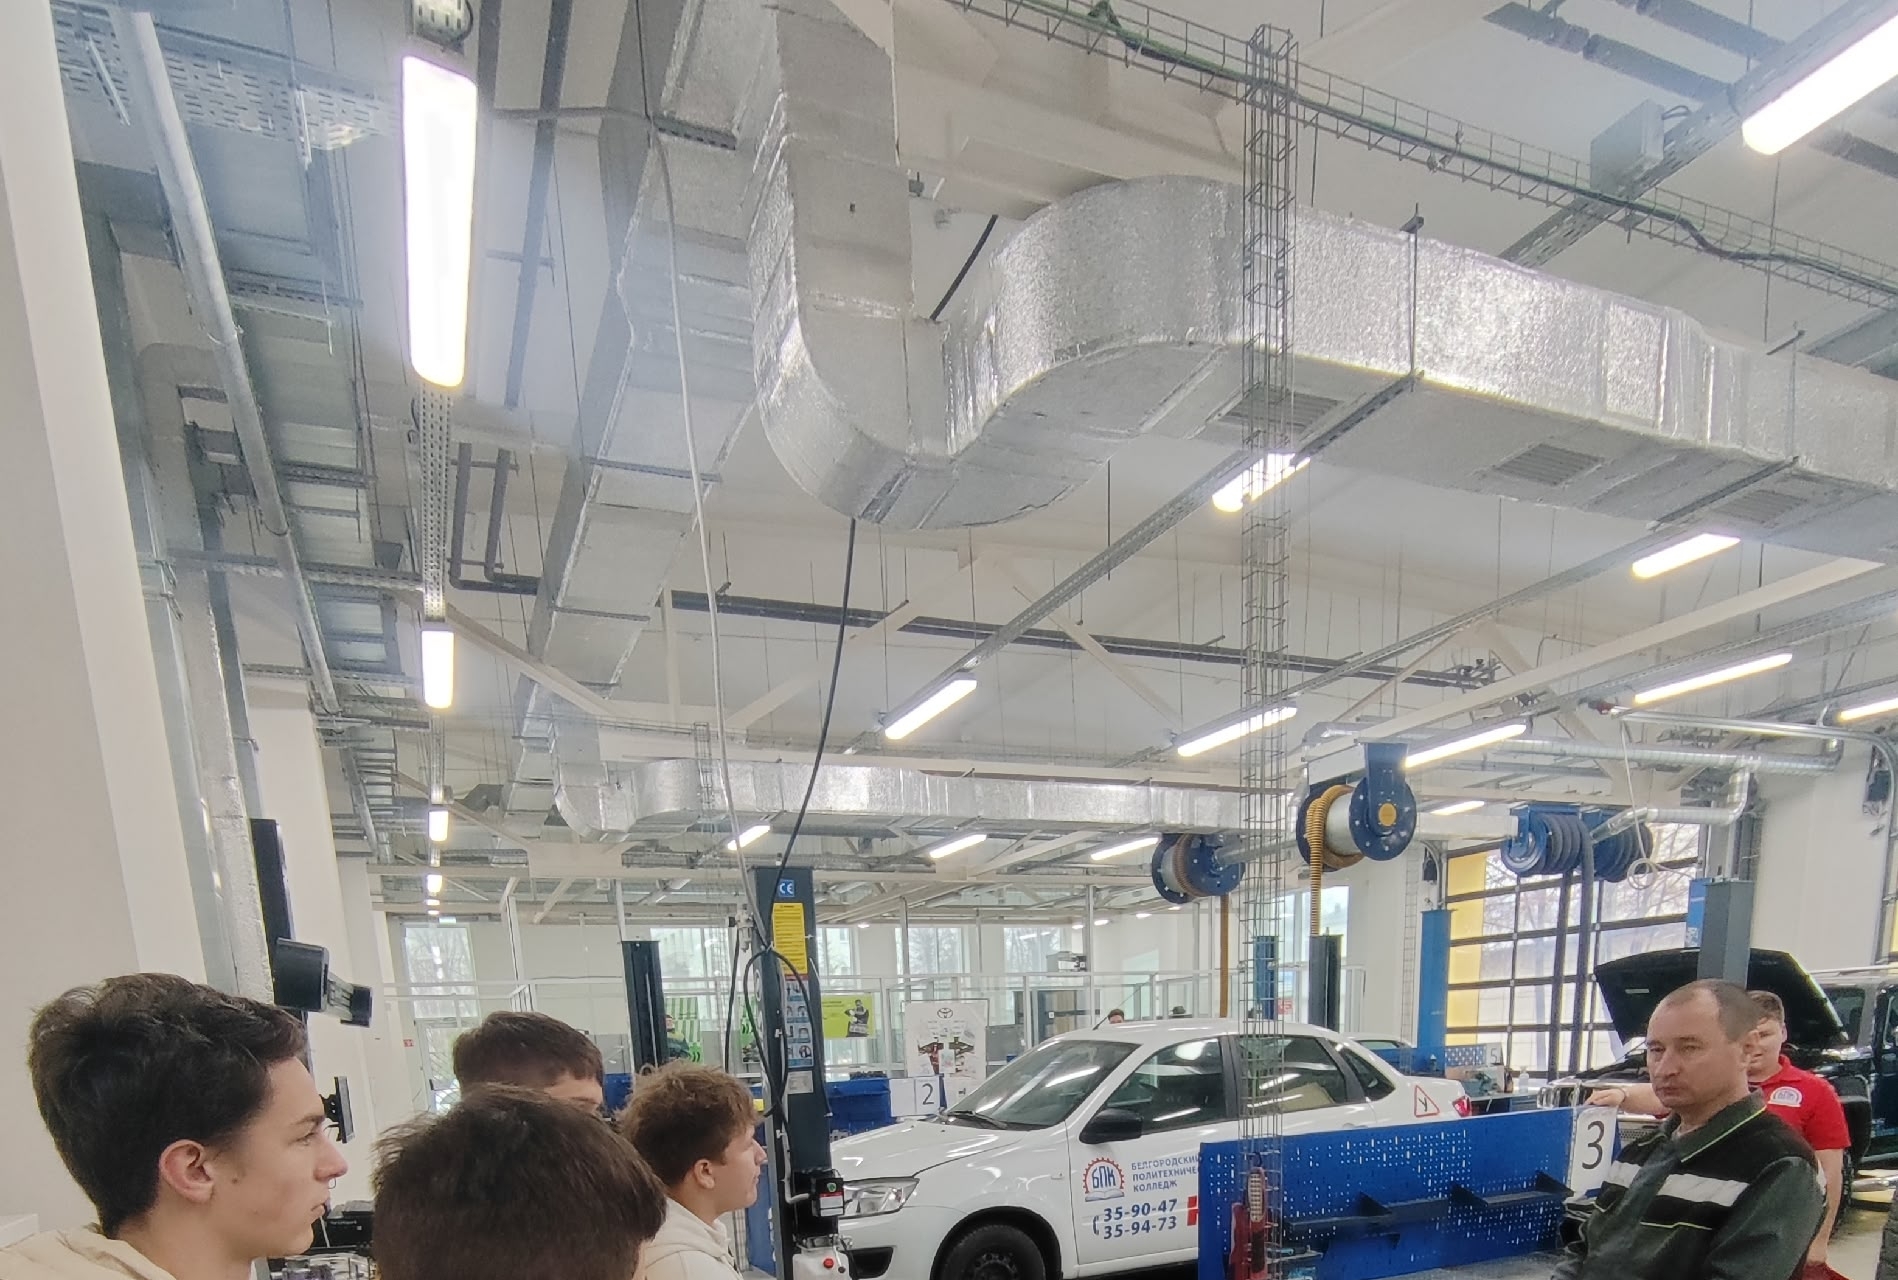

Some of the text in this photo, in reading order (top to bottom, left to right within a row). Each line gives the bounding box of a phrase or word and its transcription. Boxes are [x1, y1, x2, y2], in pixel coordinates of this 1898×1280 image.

[922, 1083, 935, 1105] 2
[1581, 1121, 1605, 1170] 3
[1132, 1166, 1198, 1181] ПОЛИТЕХНИЧЕ
[1133, 1180, 1177, 1192] КОЛЛЕДЖ
[1103, 1198, 1178, 1222] 35-90-47
[1103, 1216, 1177, 1240] 35-94-73
